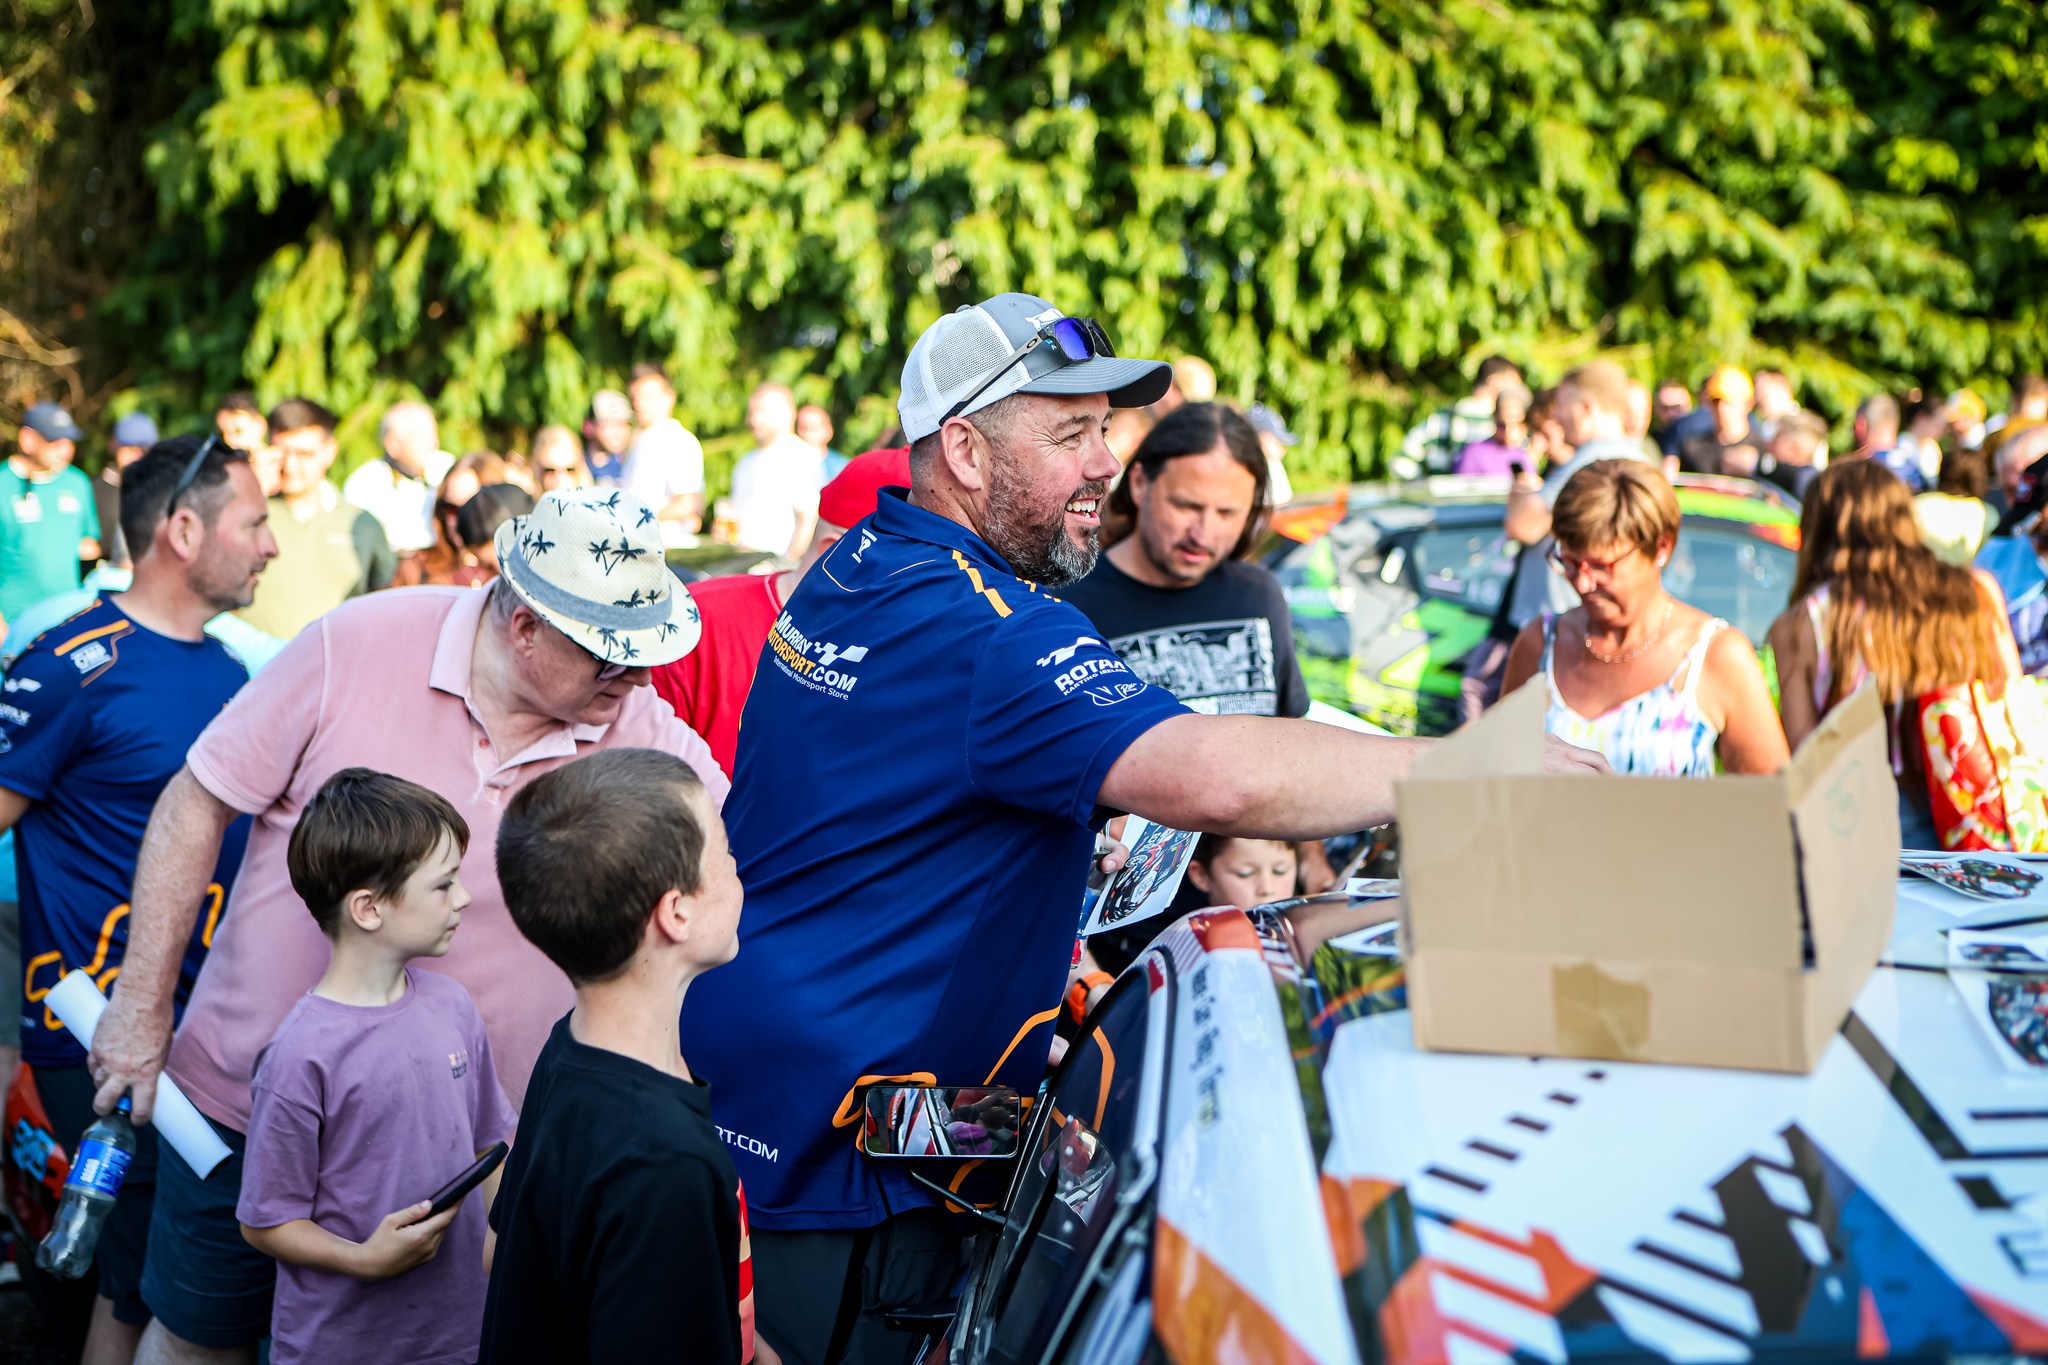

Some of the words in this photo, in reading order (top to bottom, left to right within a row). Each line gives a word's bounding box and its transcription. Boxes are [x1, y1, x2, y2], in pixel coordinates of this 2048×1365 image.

[776, 610, 813, 655] MURRAY
[793, 672, 827, 693] Motorsport
[828, 687, 849, 700] Store
[1063, 673, 1098, 696] KARTING
